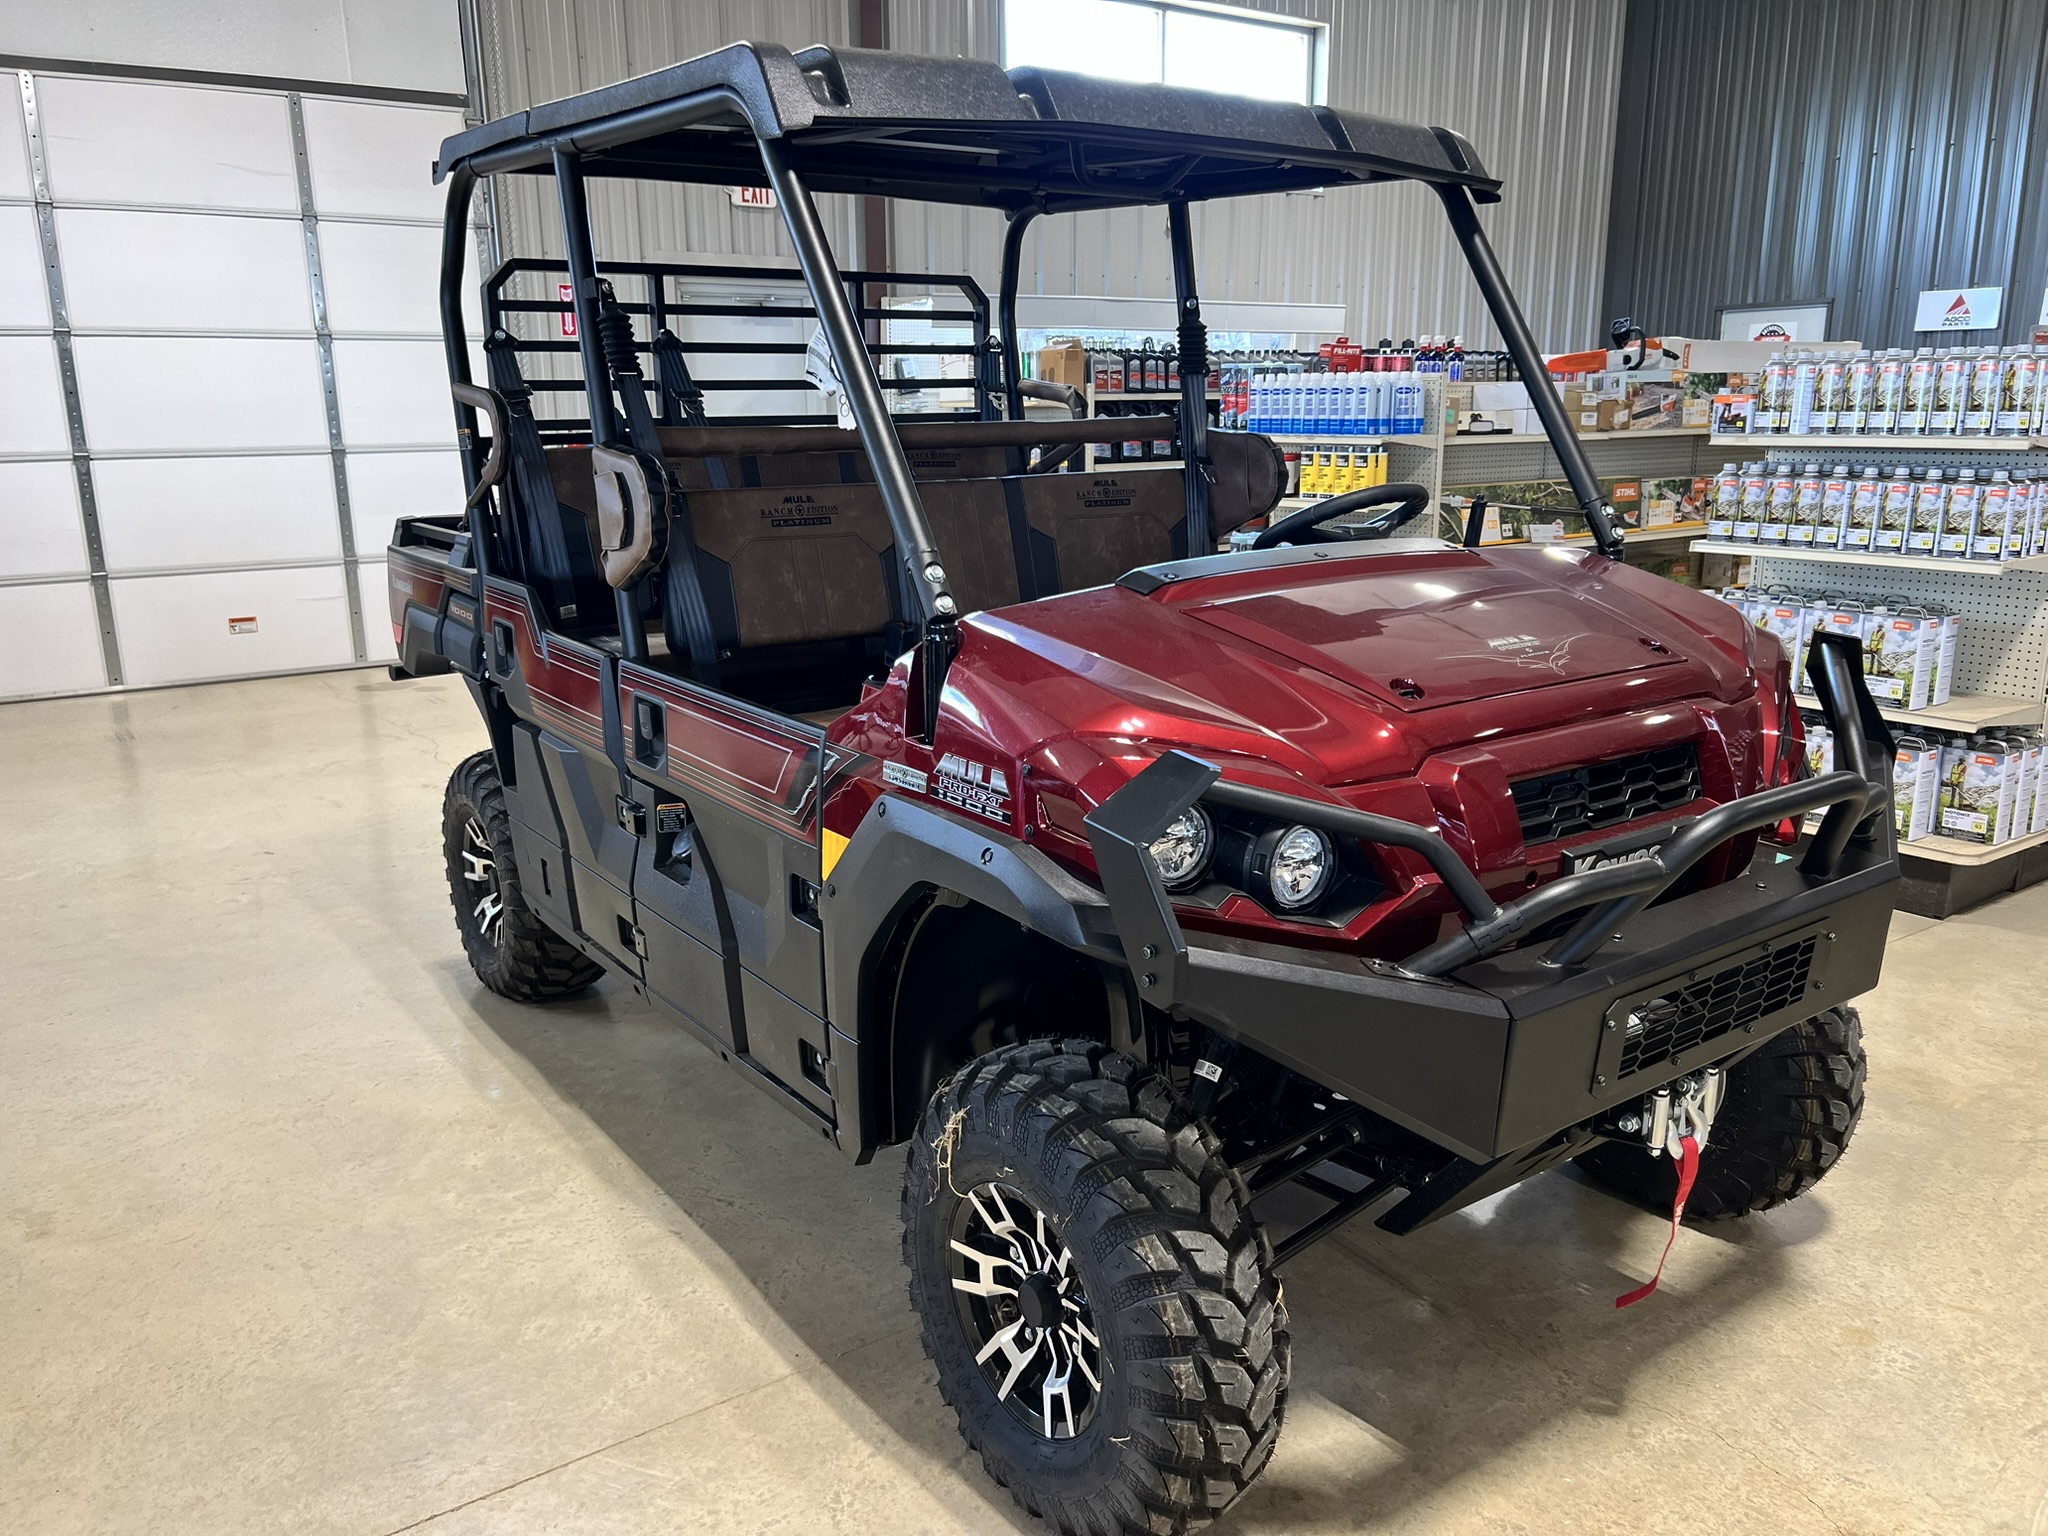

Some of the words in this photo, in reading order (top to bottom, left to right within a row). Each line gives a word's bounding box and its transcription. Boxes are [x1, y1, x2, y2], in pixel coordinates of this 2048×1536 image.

[742, 186, 769, 204] EXIT
[1333, 347, 1360, 355] FILL-RITE
[1093, 479, 1119, 487] MULE
[1076, 490, 1102, 498] RANCH
[1111, 488, 1137, 496] EDITION
[1615, 487, 1637, 497] STIHL
[782, 495, 816, 505] MULE
[760, 507, 794, 517] RANCH
[807, 504, 839, 514] EDITION
[772, 518, 831, 527] PLATINUM
[450, 605, 473, 621] 1000
[1976, 757, 1995, 765] STIHL
[934, 752, 1012, 800] MULE
[939, 776, 1003, 808] PRO-FXT
[937, 788, 1003, 821] 1000
[1974, 823, 1983, 831] 93
